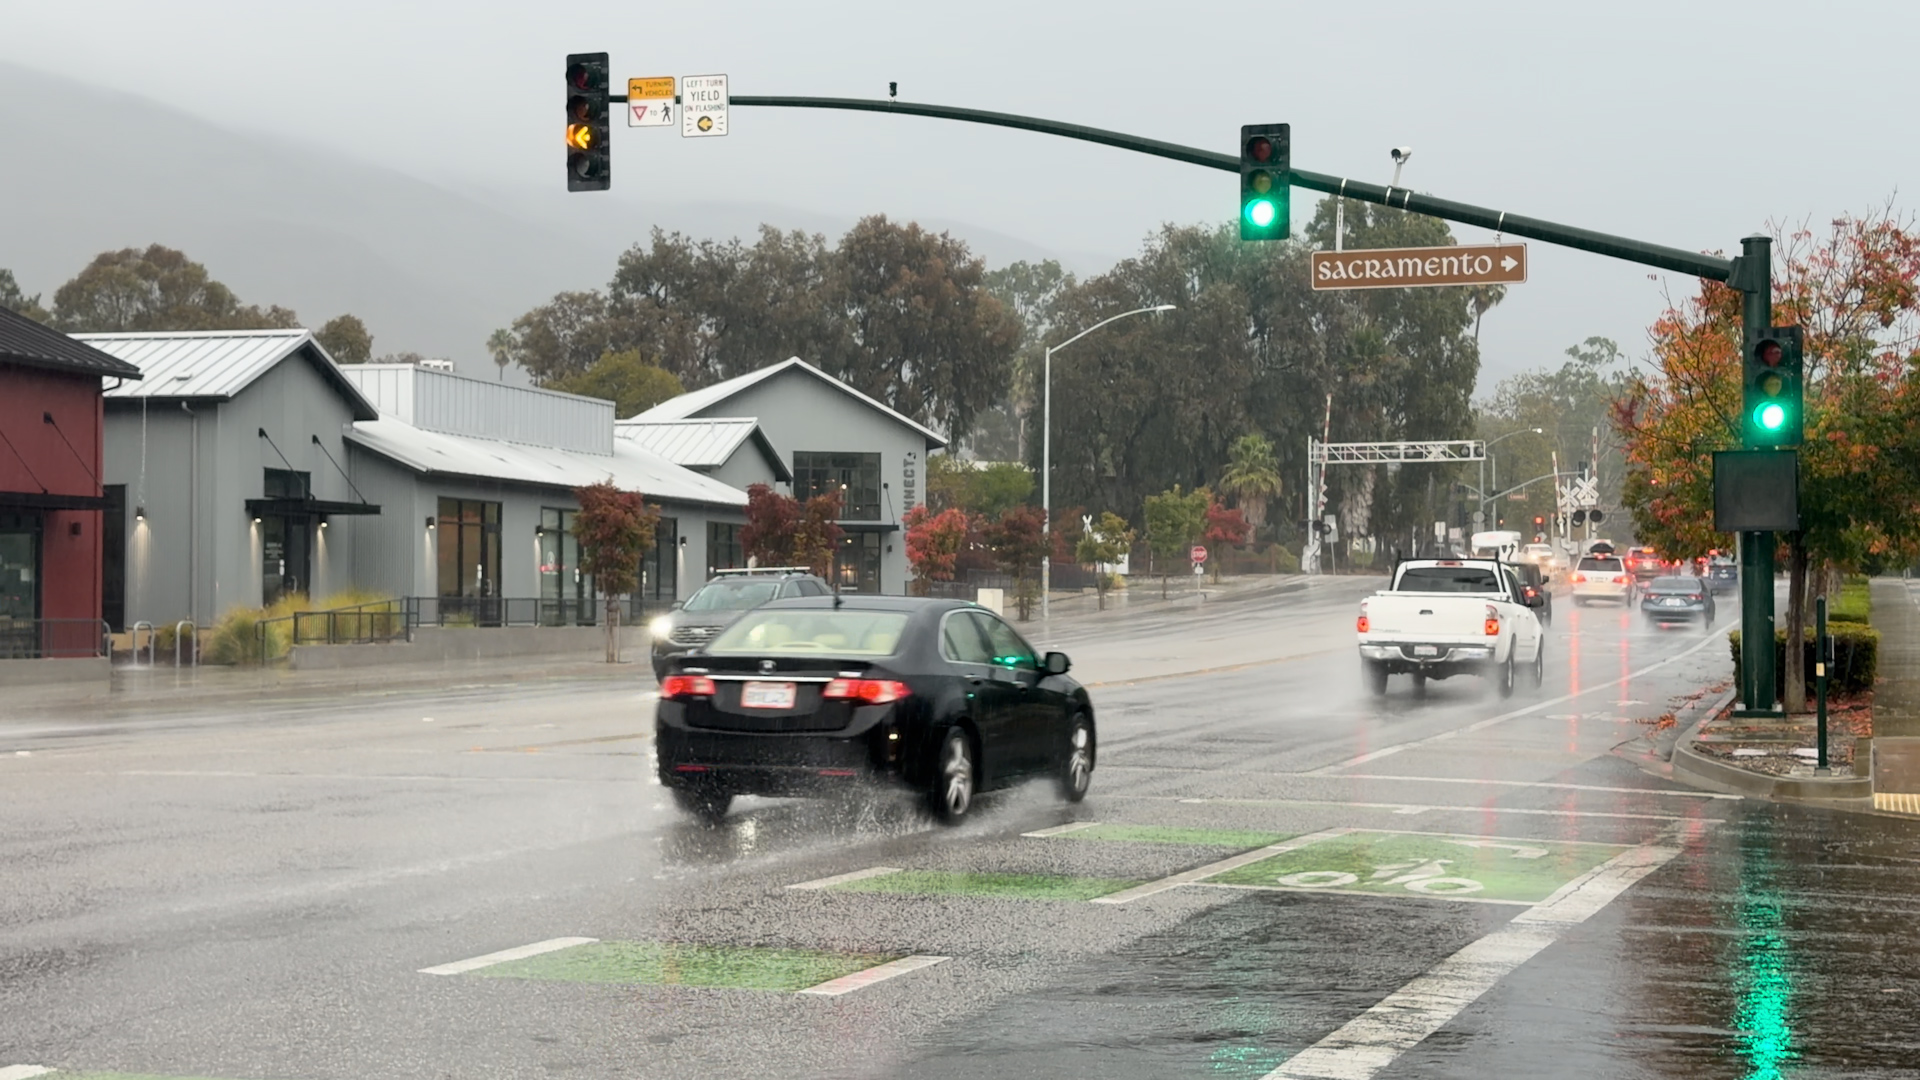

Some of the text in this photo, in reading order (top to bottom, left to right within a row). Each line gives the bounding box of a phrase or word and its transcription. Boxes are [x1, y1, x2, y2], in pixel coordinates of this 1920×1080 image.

[686, 79, 724, 88] LEFT TURN
[644, 89, 673, 97] VEHICLES
[690, 90, 720, 102] YIELD
[695, 103, 725, 112] FLASHING
[1318, 252, 1493, 280] SACRAMENTO
